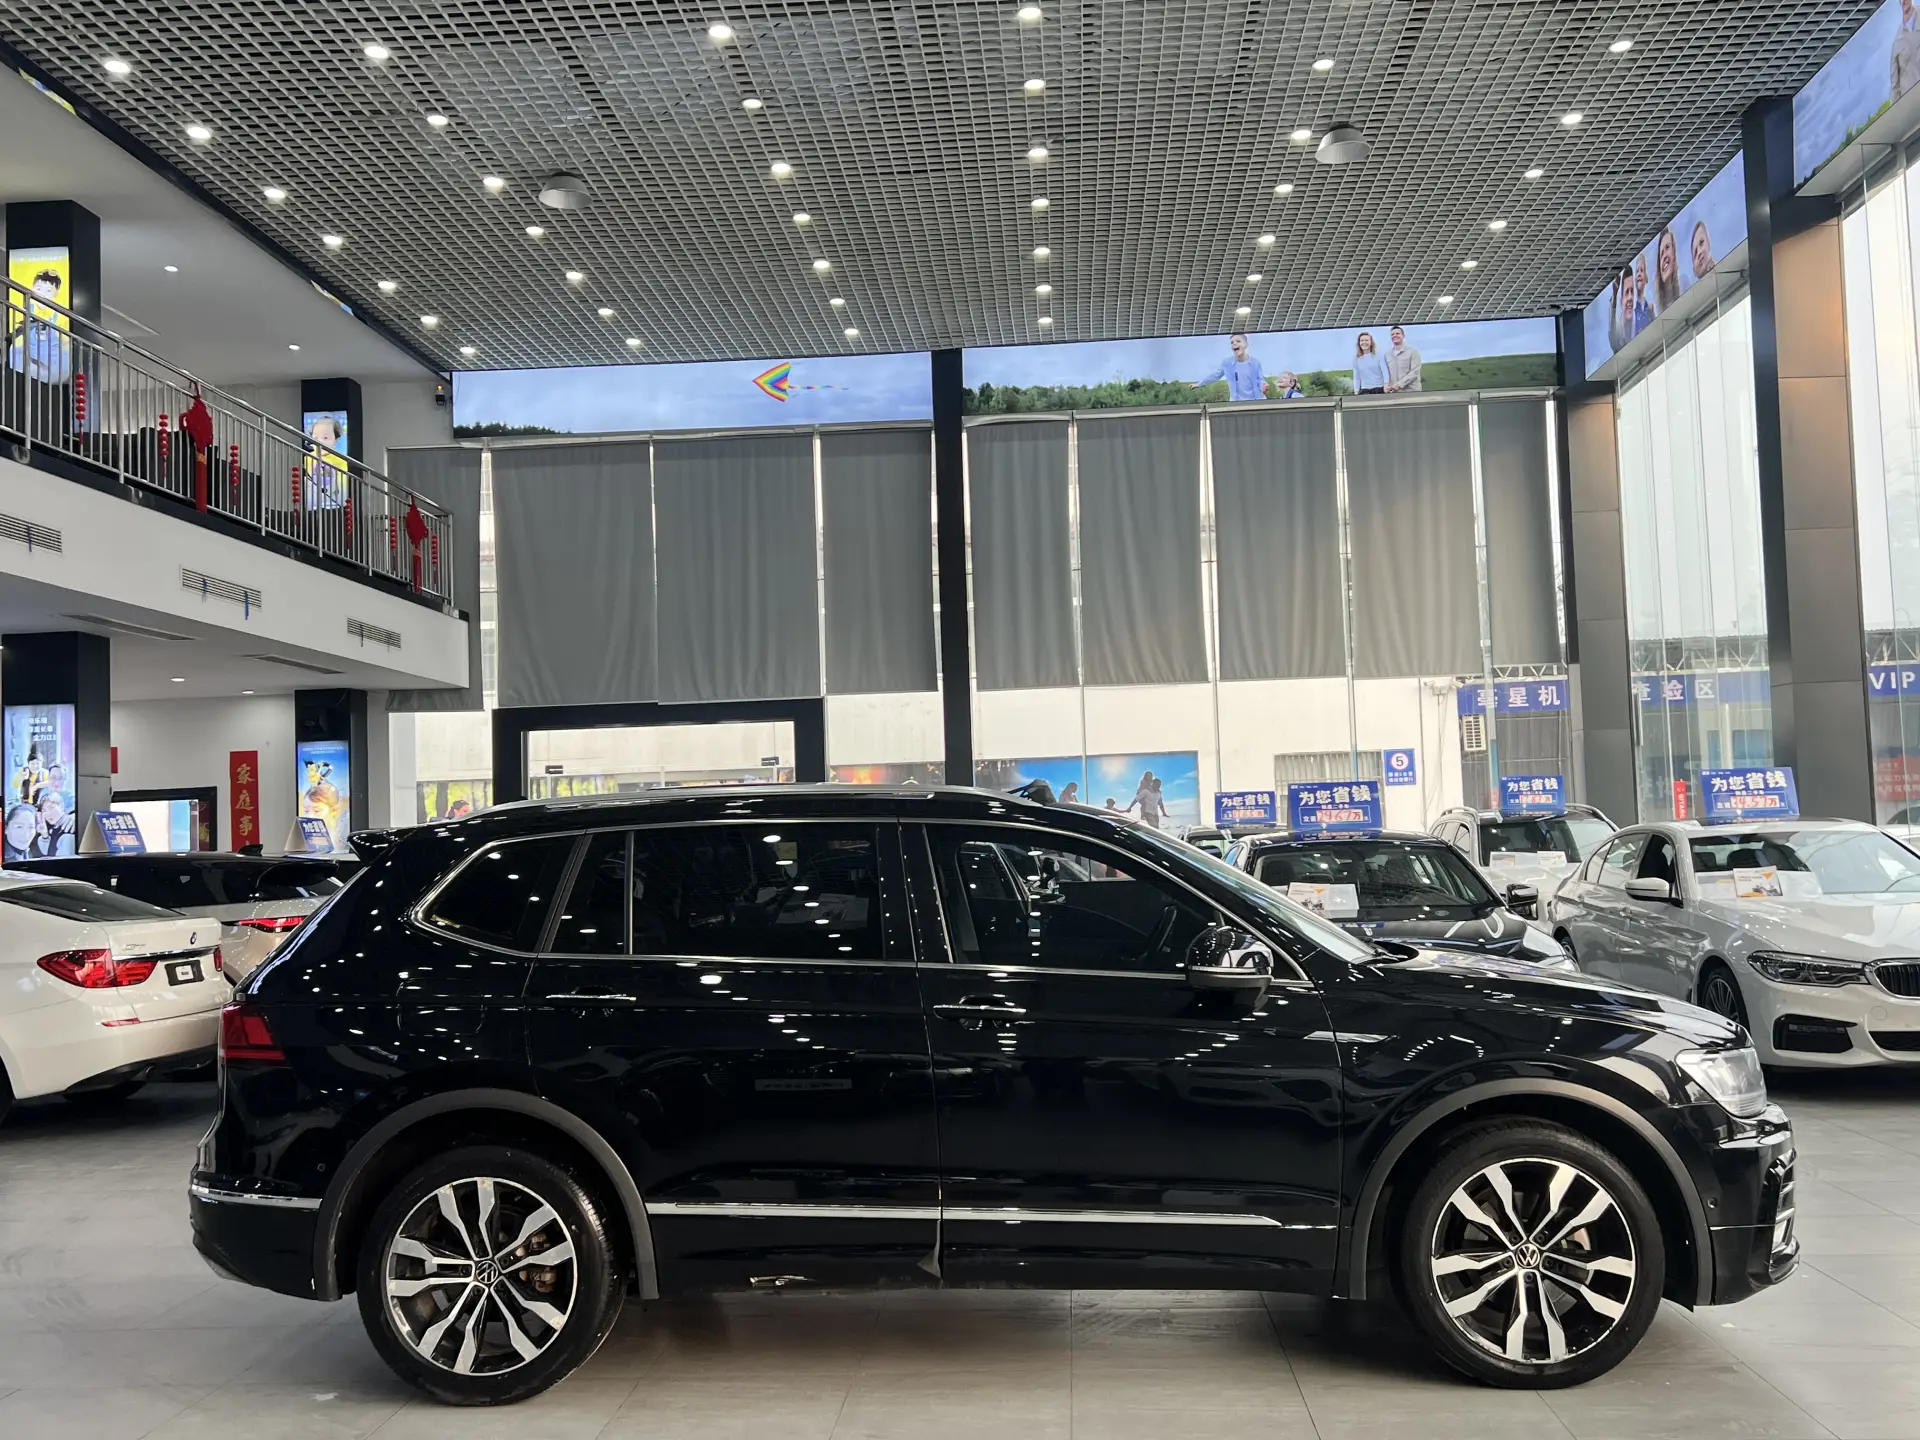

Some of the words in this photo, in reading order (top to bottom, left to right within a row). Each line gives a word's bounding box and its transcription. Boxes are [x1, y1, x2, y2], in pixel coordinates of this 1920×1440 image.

[1869, 671, 1916, 690] VIP
[1395, 755, 1405, 767] 5
[1507, 777, 1558, 793] 为您省钱
[1711, 770, 1787, 793] 为您省钱
[235, 763, 255, 845] 家庭事
[1221, 793, 1270, 807] 为您省钱
[1299, 784, 1371, 806] 为您省钱
